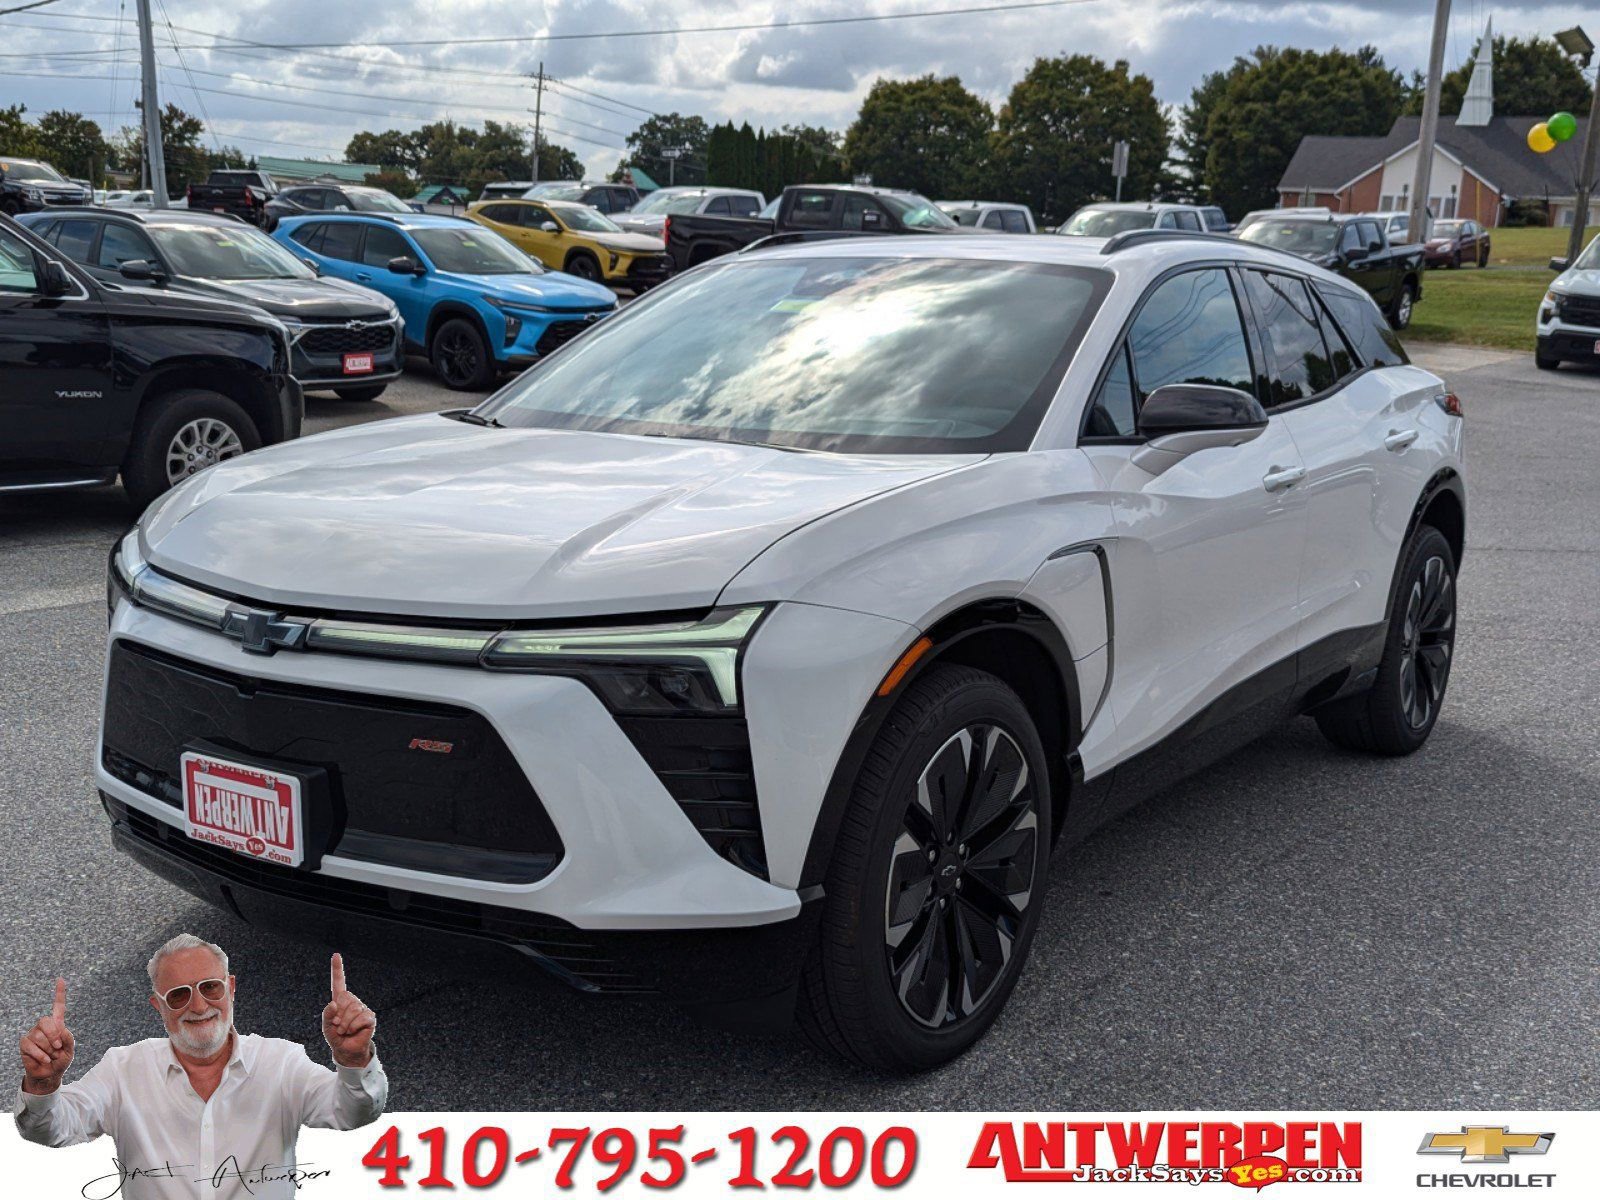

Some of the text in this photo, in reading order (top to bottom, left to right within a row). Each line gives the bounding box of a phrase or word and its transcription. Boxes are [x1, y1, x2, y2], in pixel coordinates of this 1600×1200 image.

[54, 390, 103, 399] YUKON
[408, 738, 453, 753] RS
[193, 773, 290, 845] ANTWERPEN
